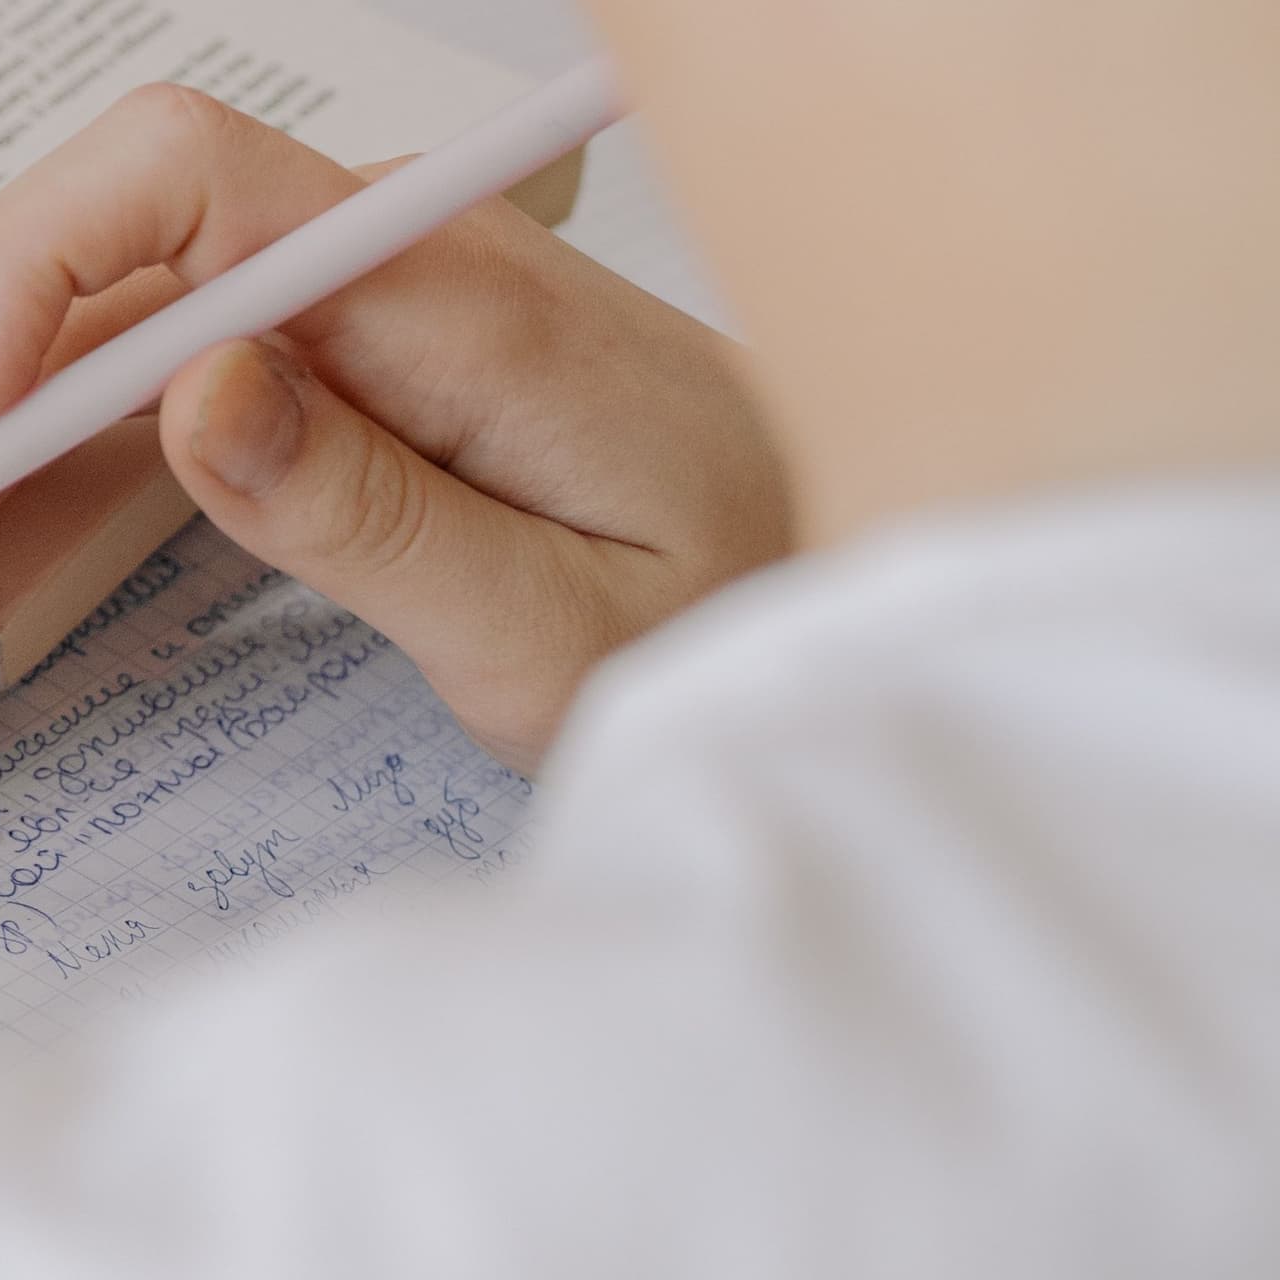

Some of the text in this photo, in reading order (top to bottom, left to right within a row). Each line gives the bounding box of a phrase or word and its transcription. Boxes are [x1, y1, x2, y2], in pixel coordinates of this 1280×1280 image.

[46, 754, 416, 980] Меня зовут Лиза
